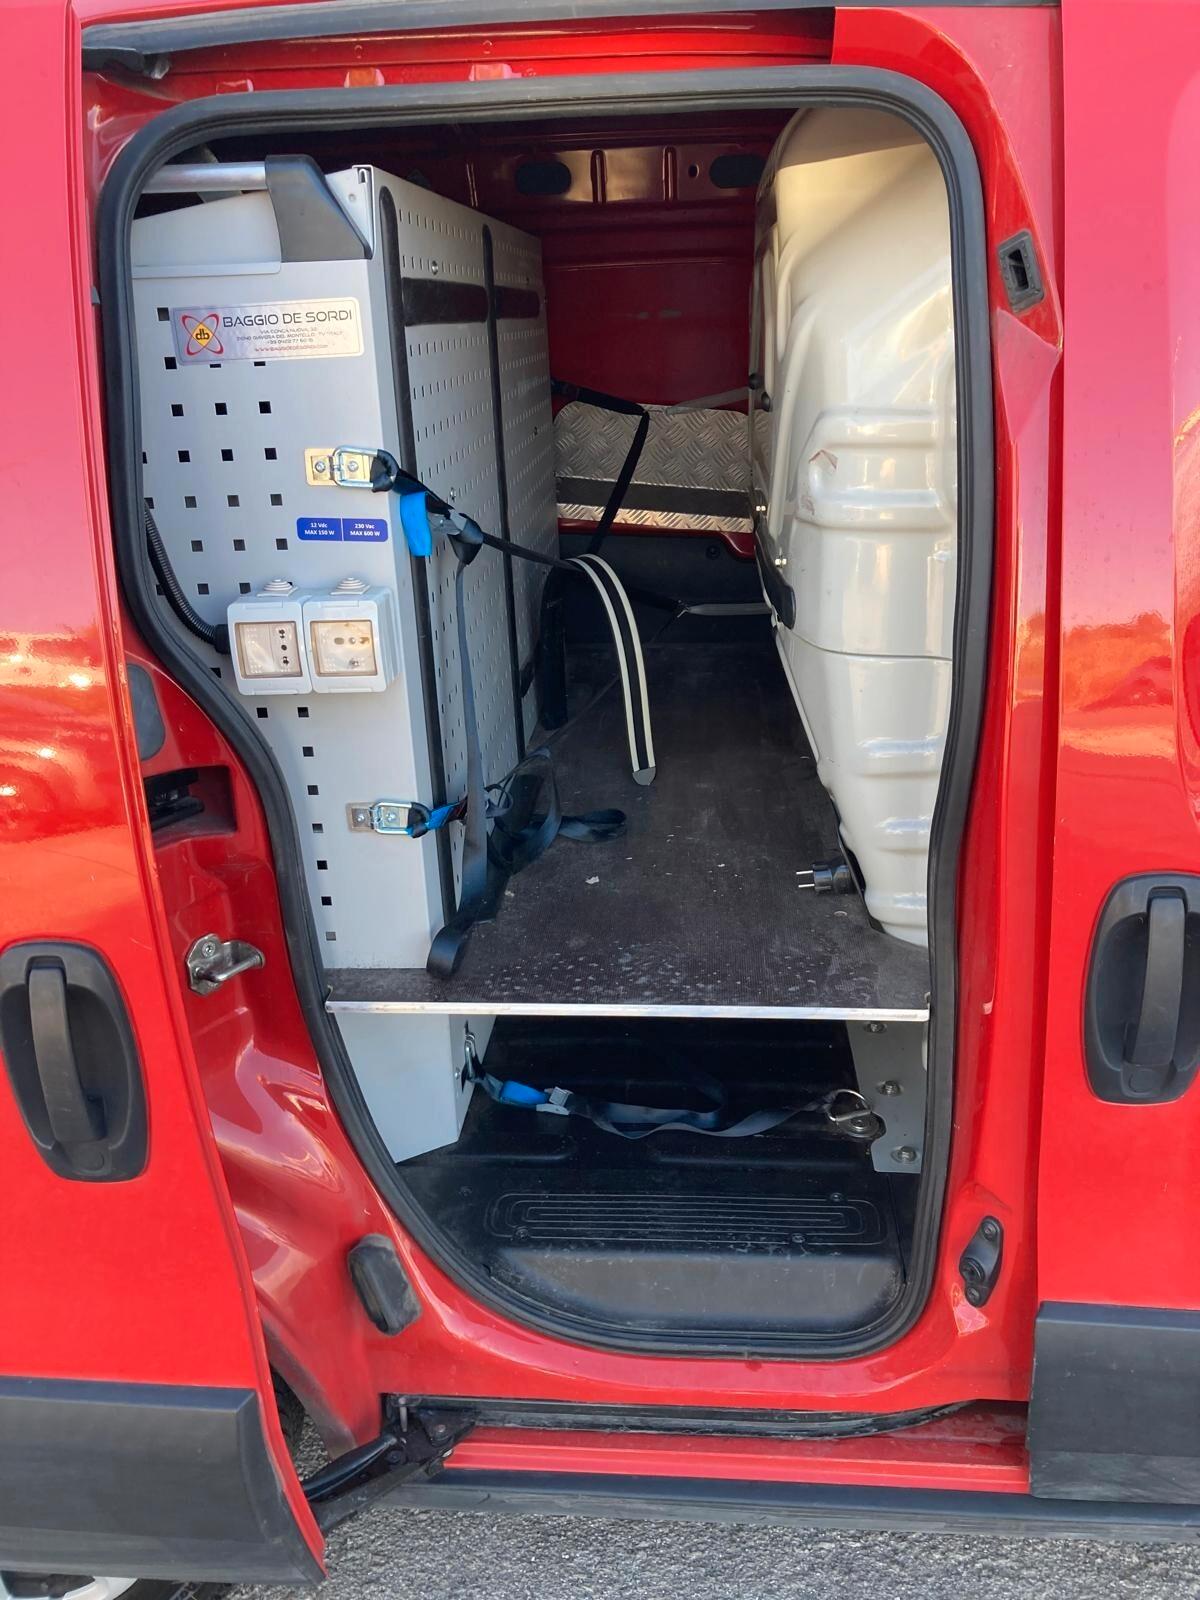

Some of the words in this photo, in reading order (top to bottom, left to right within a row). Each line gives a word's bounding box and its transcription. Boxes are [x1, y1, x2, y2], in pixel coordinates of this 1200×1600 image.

[222, 313, 279, 328] BAGGIO
[282, 312, 303, 324] DE
[305, 309, 352, 322] SORDI
